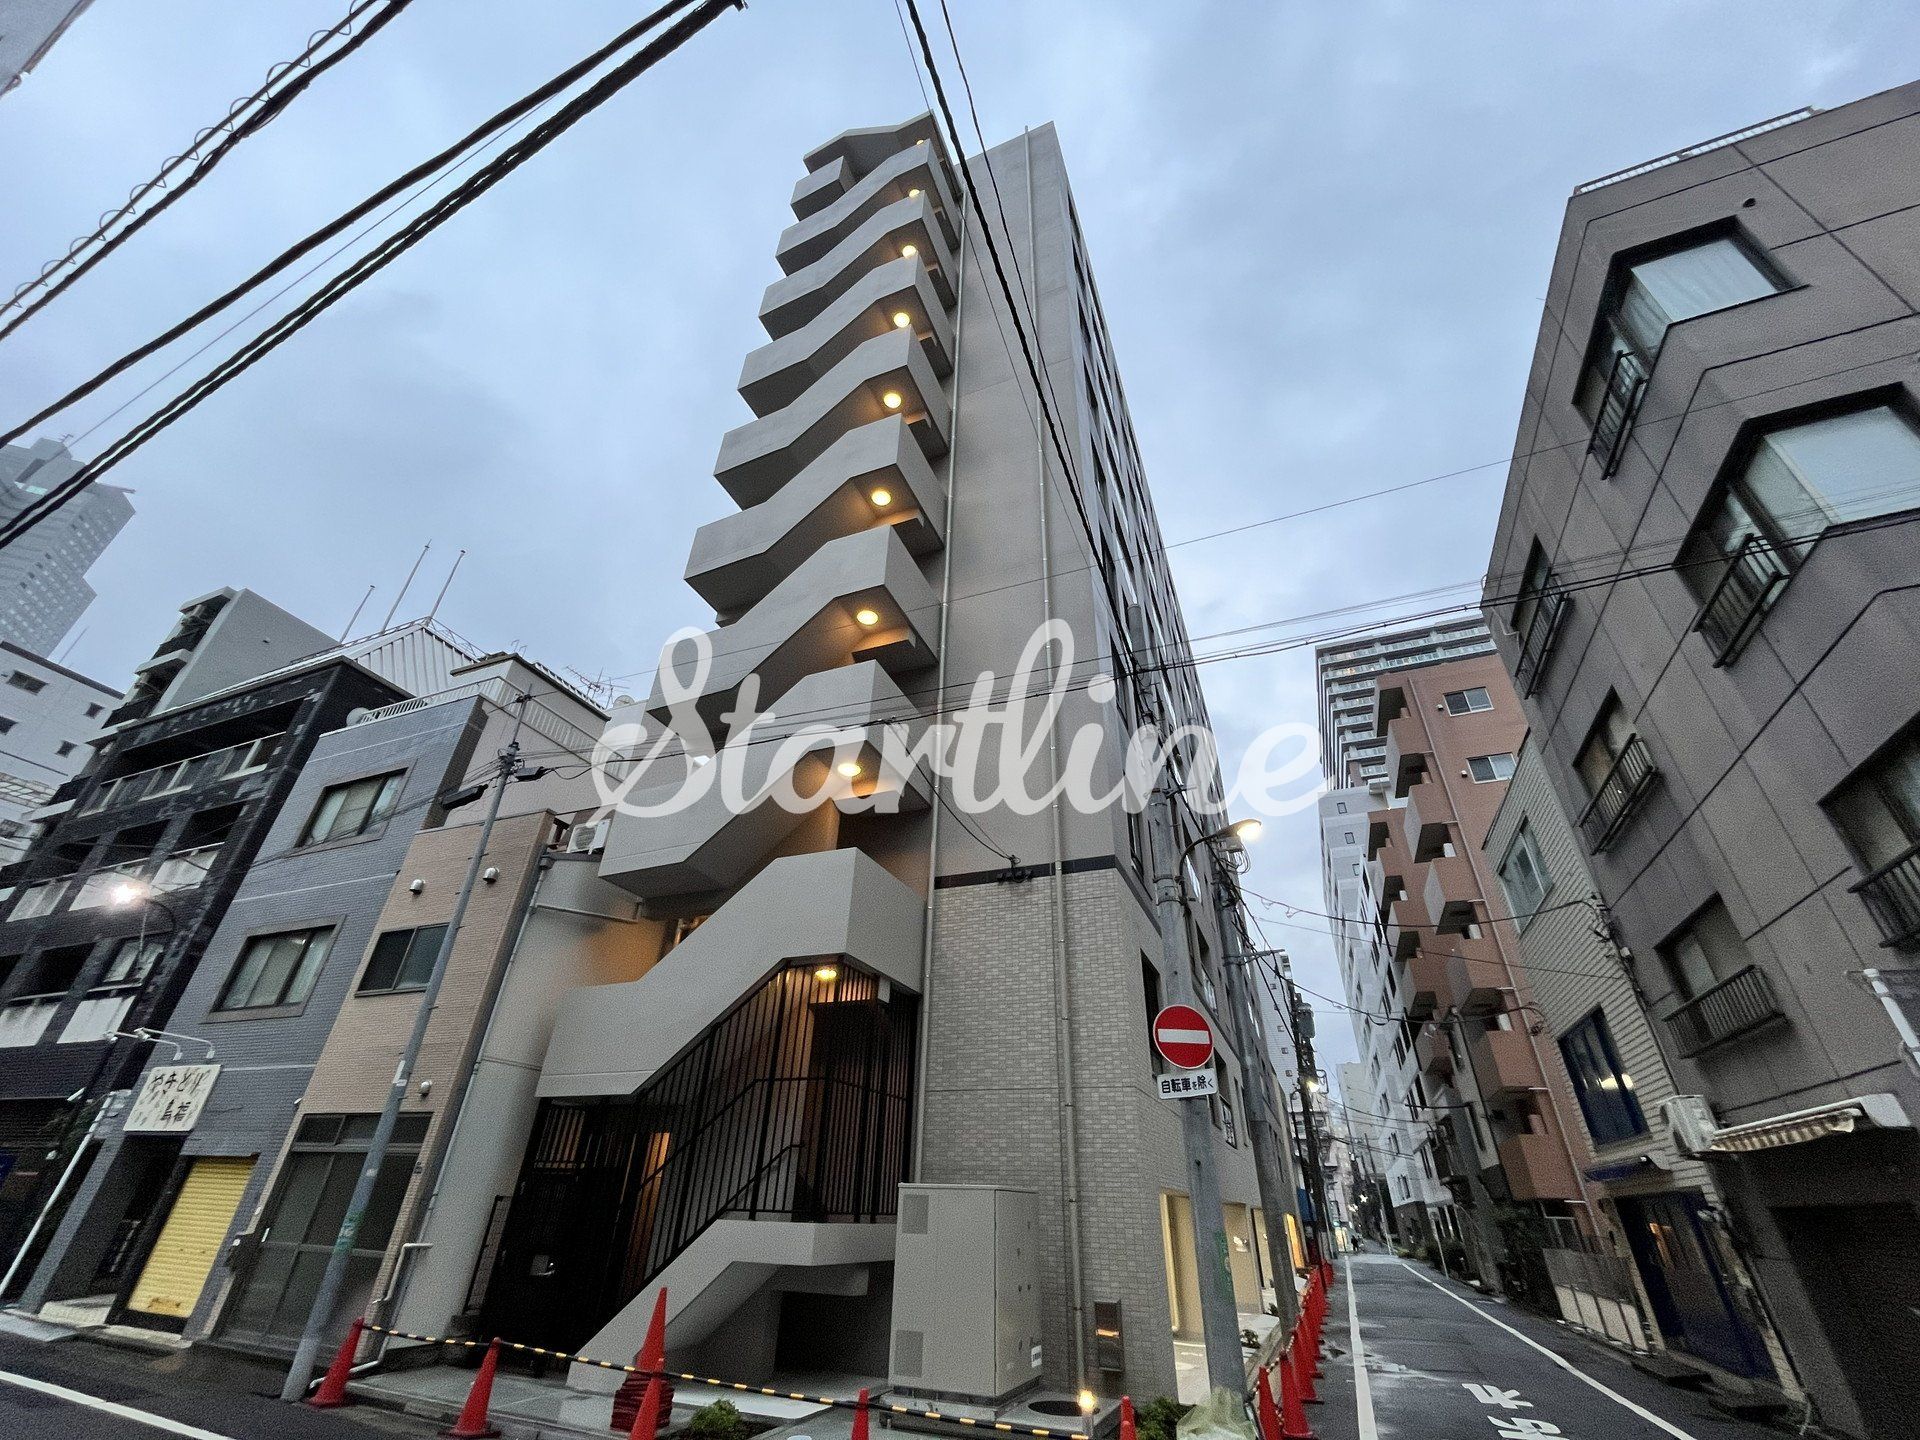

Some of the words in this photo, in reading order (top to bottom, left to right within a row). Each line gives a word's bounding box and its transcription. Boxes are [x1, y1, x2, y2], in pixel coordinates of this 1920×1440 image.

[1161, 1075, 1214, 1094] 自転車を除く
